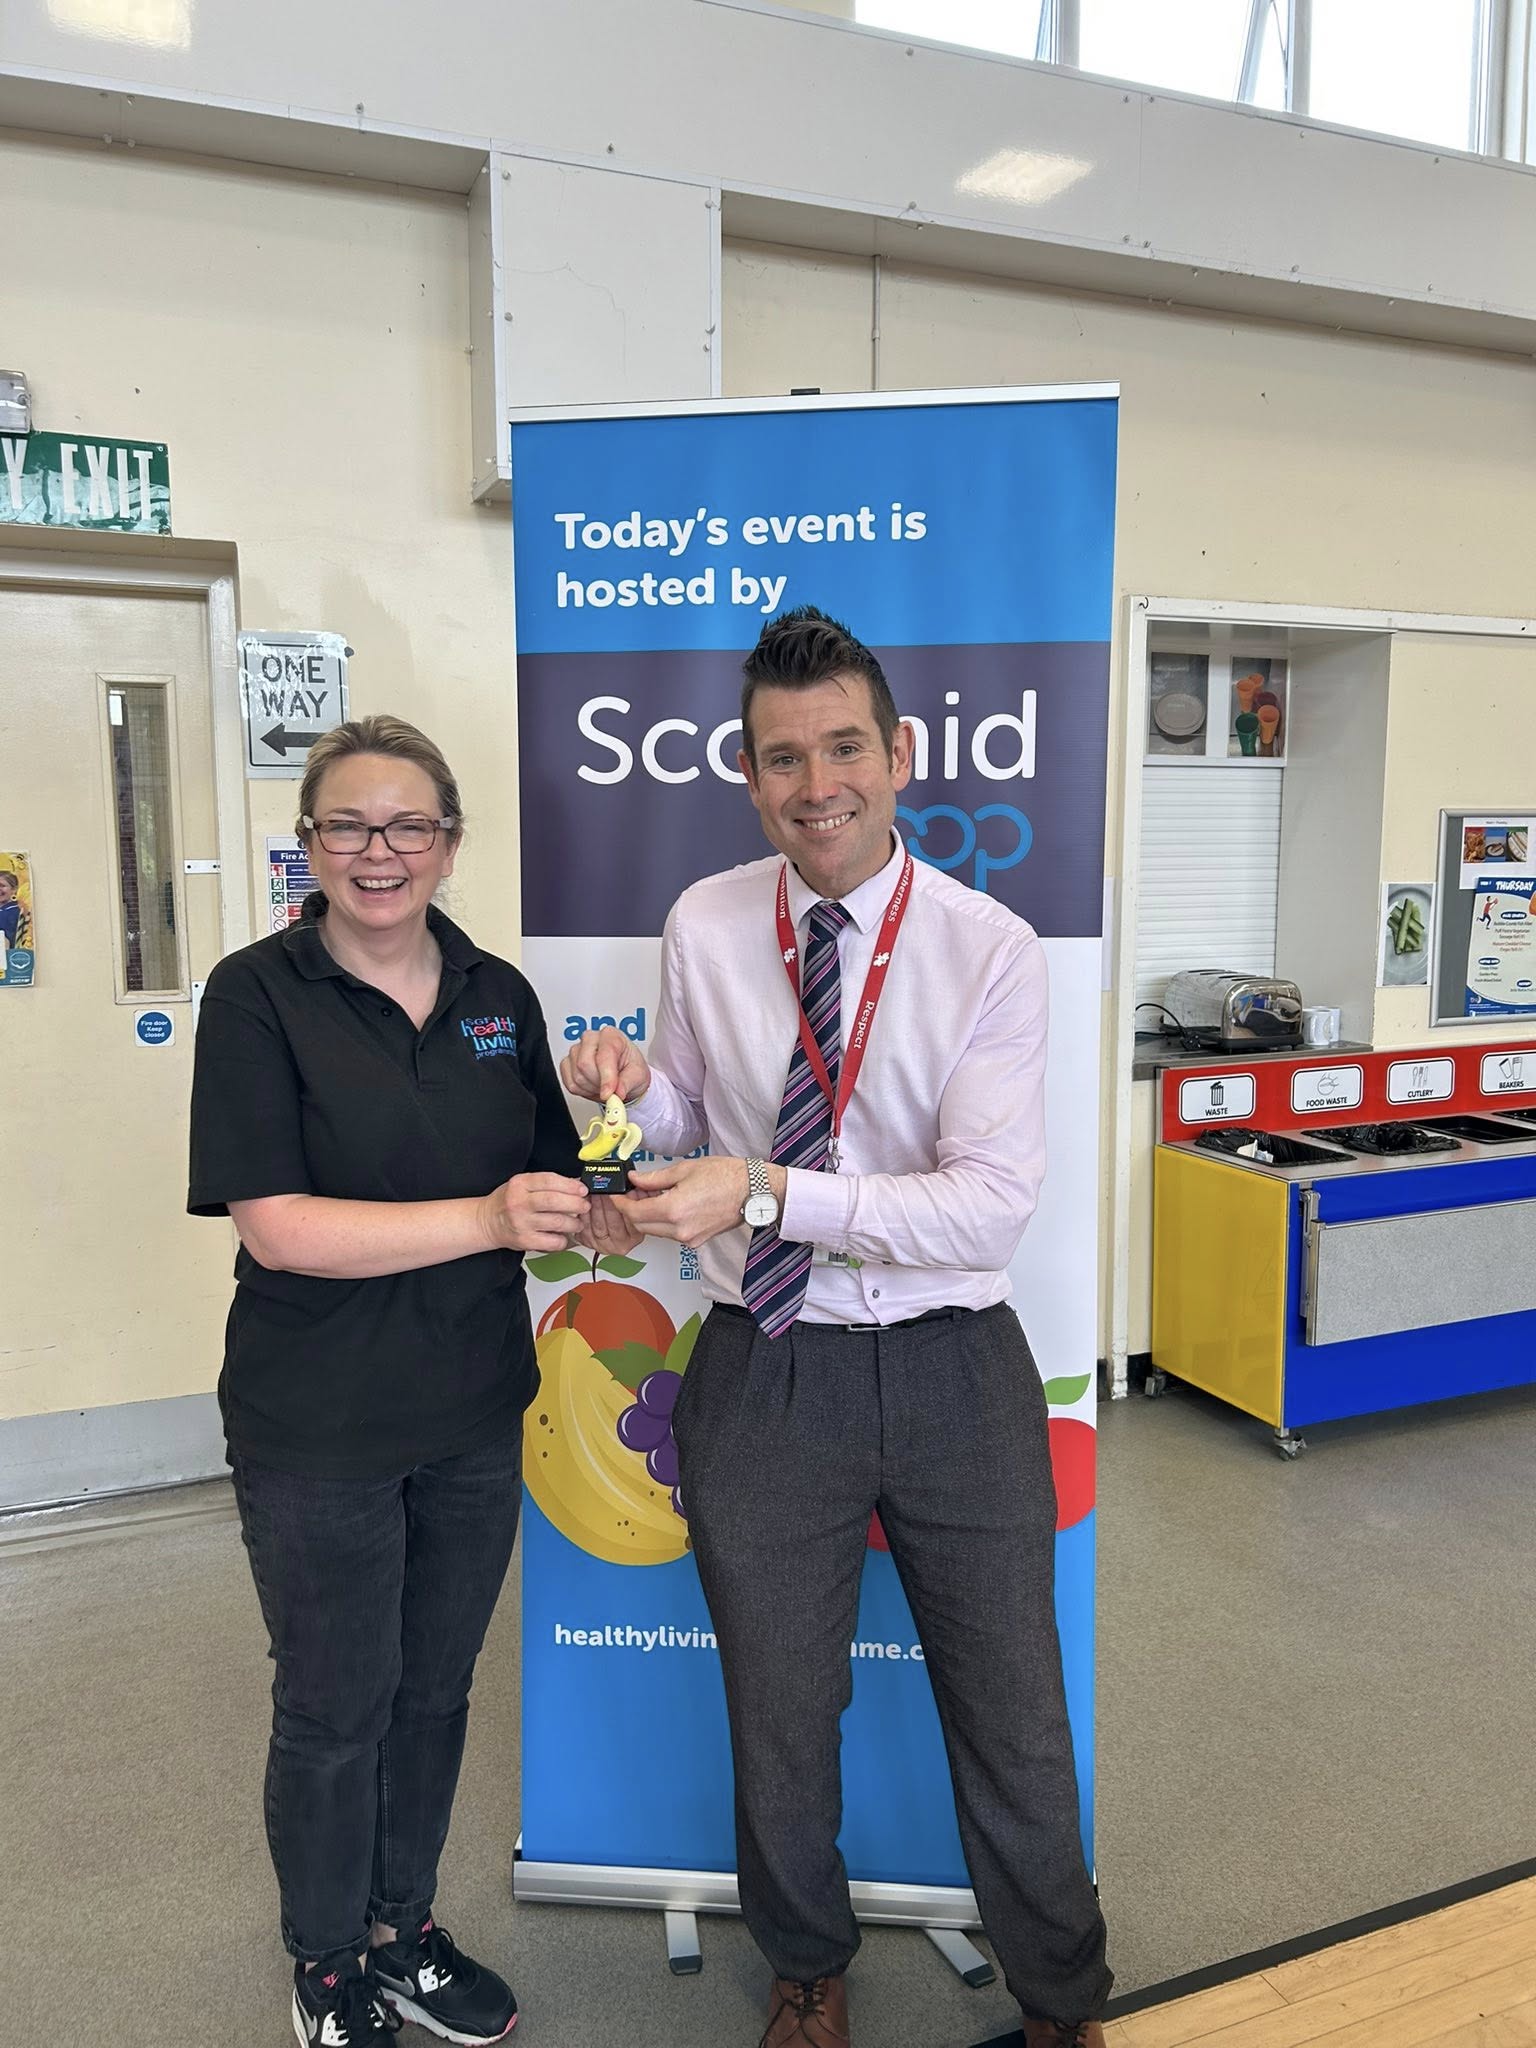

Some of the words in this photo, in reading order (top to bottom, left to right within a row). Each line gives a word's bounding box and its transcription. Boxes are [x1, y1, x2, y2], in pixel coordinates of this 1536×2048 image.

[60, 442, 154, 521] EXIT
[554, 507, 729, 556] Today's
[742, 506, 876, 546] event
[890, 502, 928, 541] is
[556, 567, 715, 608] hosted
[731, 567, 788, 614] by
[261, 654, 326, 683] ONE
[260, 689, 329, 718] WAY
[280, 852, 297, 860] Fire
[1495, 880, 1534, 891] THURSDAY
[460, 1016, 516, 1037] health
[563, 1007, 646, 1042] and
[853, 1000, 875, 1049] Respect
[473, 1033, 517, 1051] livin
[1407, 1089, 1434, 1098] CUTLERY
[1498, 1080, 1525, 1089] BEAKERS
[1204, 1107, 1229, 1116] WASTE
[1305, 1099, 1326, 1107] FOOD
[1326, 1096, 1348, 1105] WASTE
